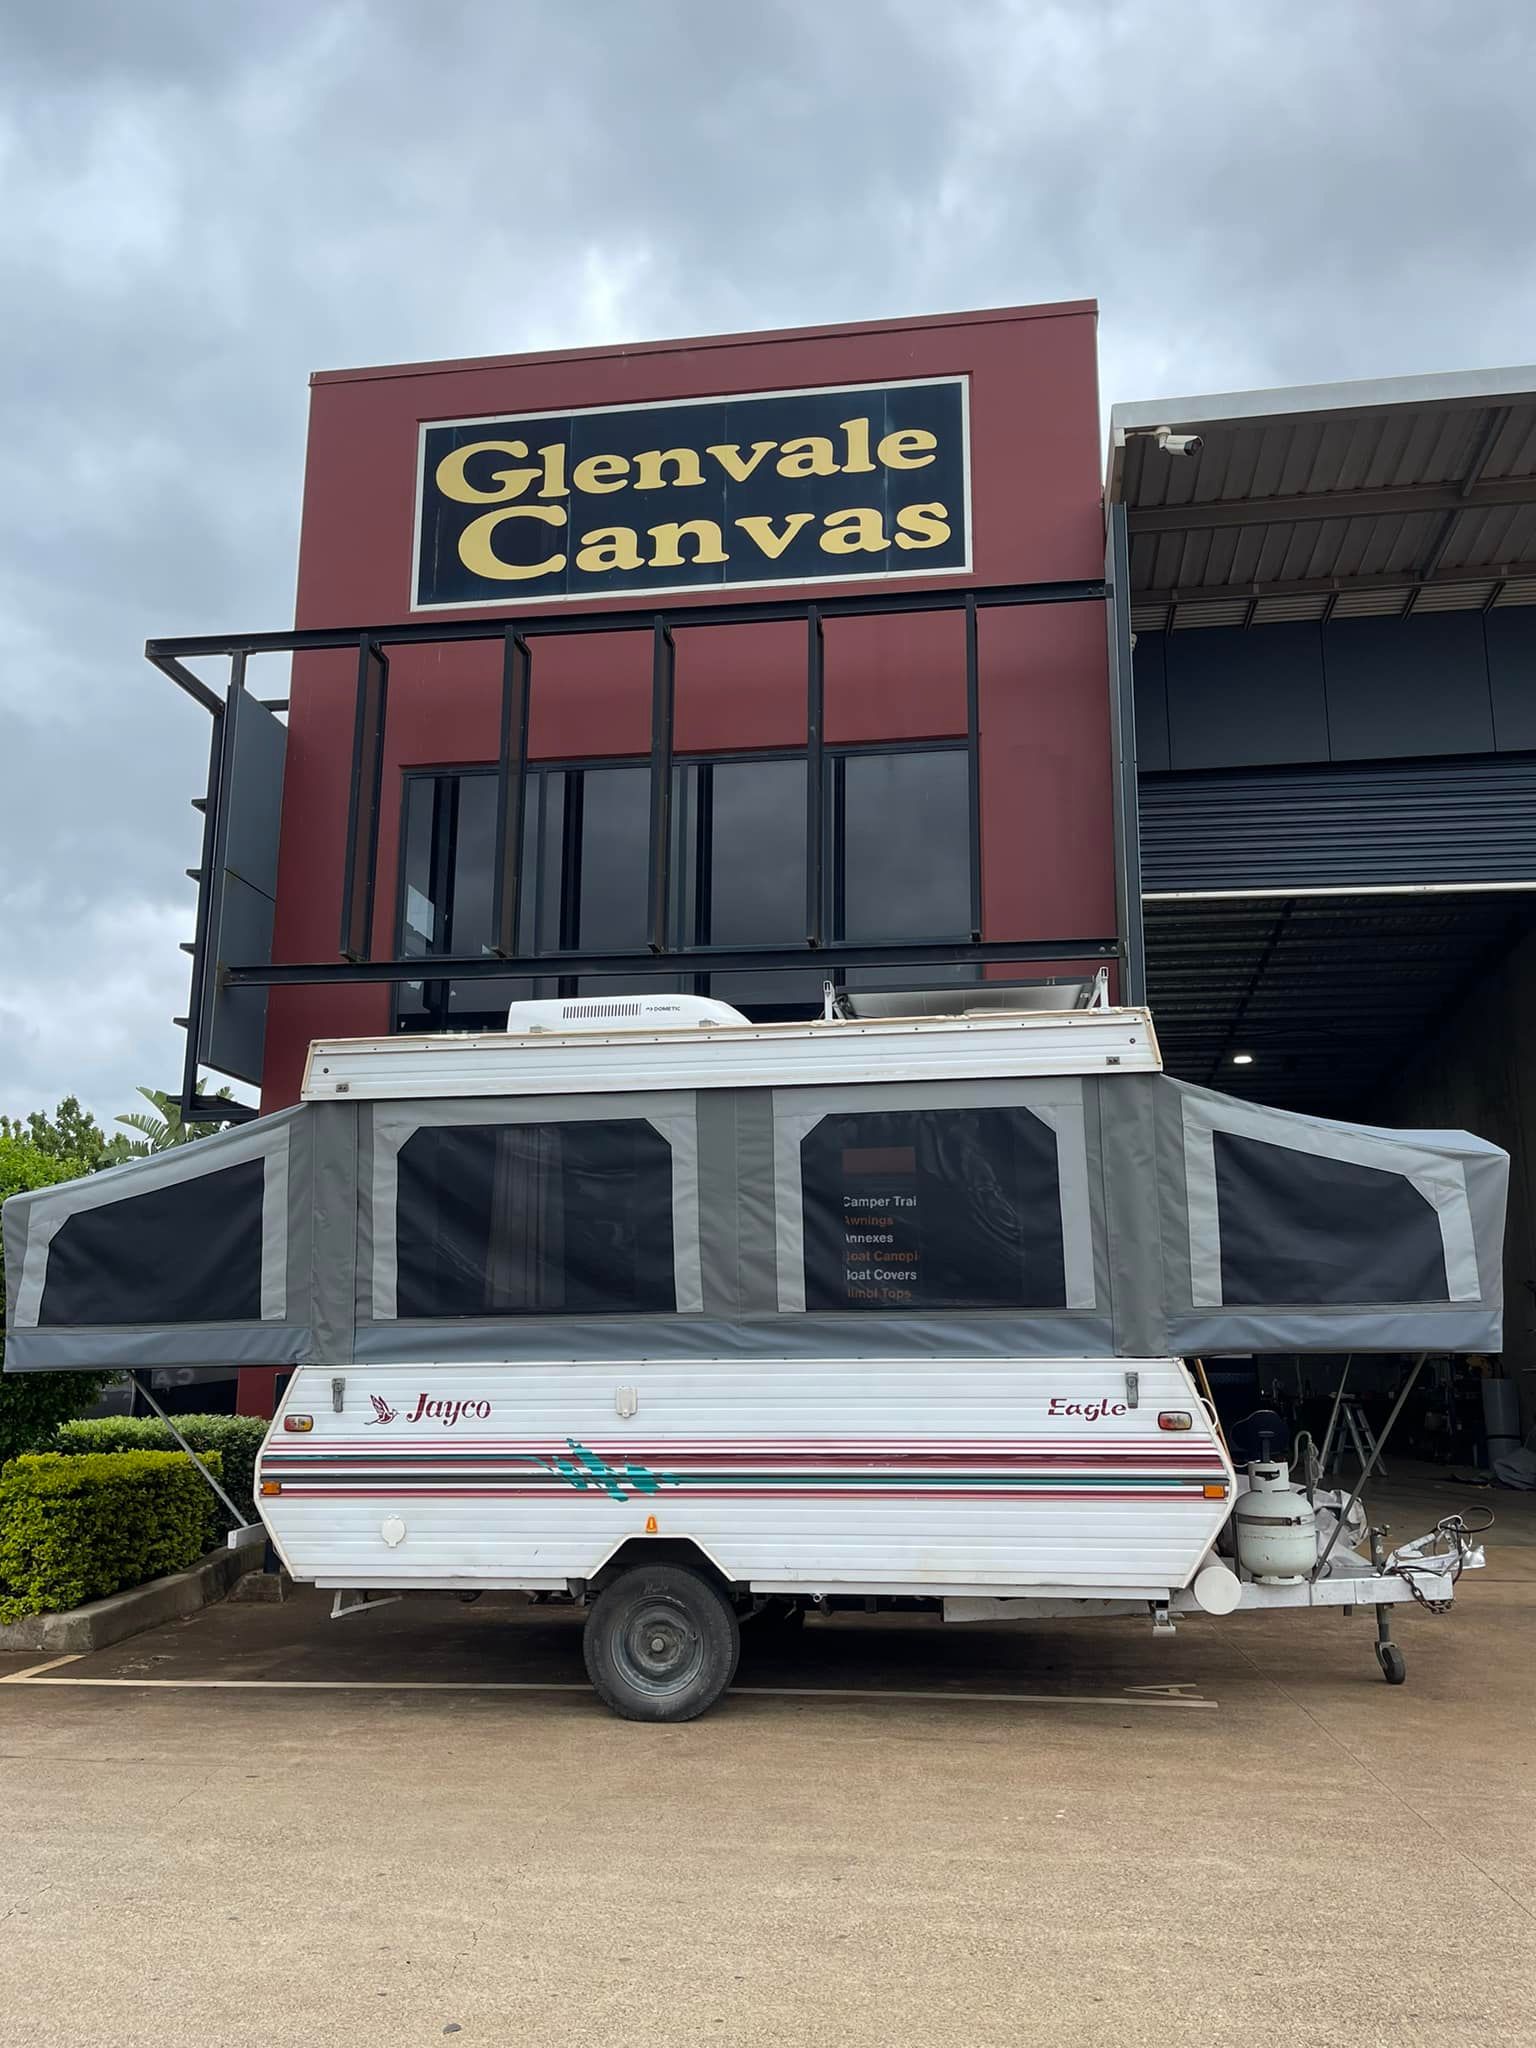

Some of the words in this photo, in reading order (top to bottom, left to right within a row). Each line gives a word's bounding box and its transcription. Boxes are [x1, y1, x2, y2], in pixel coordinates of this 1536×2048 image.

[435, 417, 938, 504] Glenvale
[458, 501, 951, 580] Canvas
[843, 1196, 890, 1208] Camper
[873, 1269, 917, 1280] Covers
[881, 1287, 912, 1301] Tops
[406, 1393, 492, 1426] Jayco
[1048, 1398, 1127, 1421] Eagle
